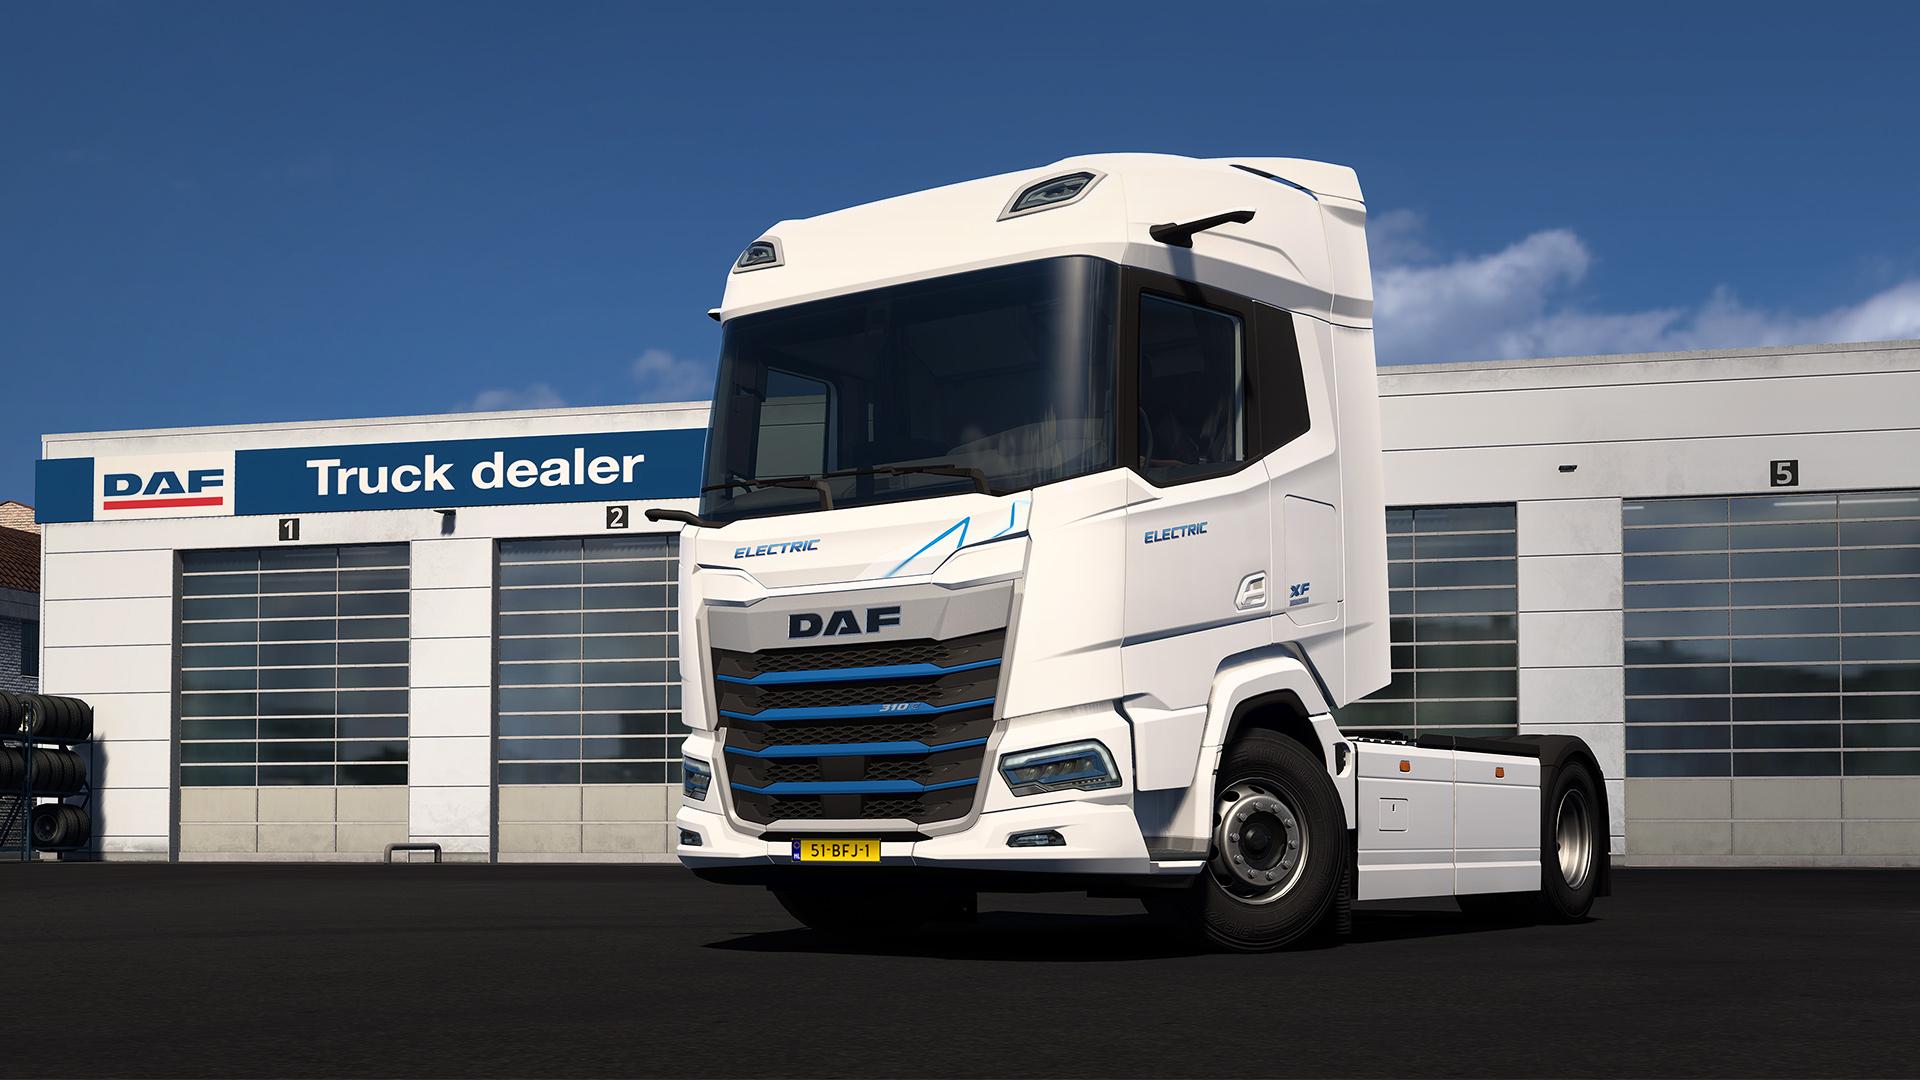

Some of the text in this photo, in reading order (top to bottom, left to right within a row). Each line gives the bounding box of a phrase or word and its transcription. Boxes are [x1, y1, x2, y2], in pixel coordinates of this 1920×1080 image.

[103, 468, 225, 497] DAF
[306, 447, 645, 496] Truck dealer
[1776, 462, 1793, 485] 5
[609, 507, 625, 529] 2
[283, 520, 294, 540] 1
[1144, 521, 1208, 544] ELECTRIC
[734, 538, 821, 559] ELECTRIC
[1289, 582, 1310, 598] XF
[787, 605, 902, 639] DAF
[811, 843, 869, 857] 51-BFJ-1
